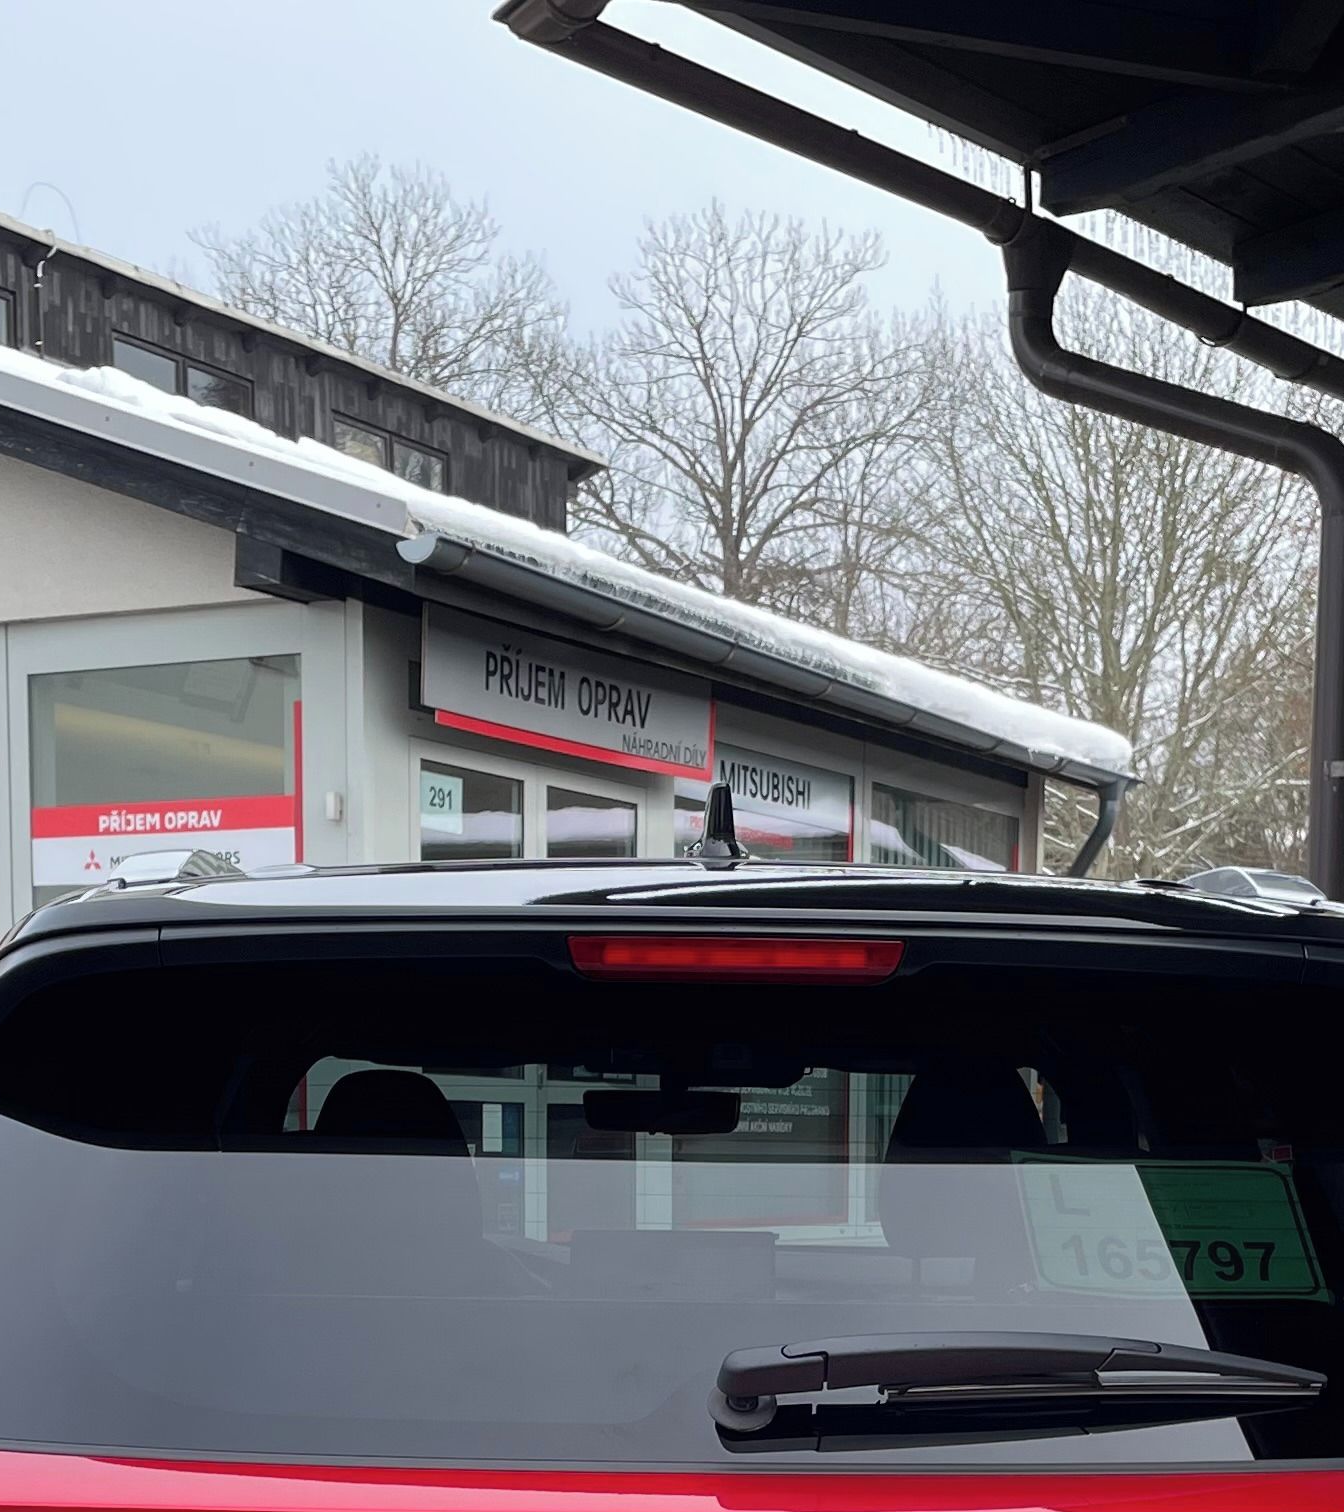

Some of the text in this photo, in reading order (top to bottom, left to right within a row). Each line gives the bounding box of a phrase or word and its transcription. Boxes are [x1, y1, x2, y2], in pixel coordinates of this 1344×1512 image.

[484, 643, 652, 729] PŘÍJEM OPRAV
[621, 731, 707, 769] NÁHRADNÍ DÍLY
[428, 785, 453, 811] 291
[720, 759, 811, 810] MITSUBISHI
[97, 809, 223, 833] PŘÍJEM OPRAV
[1049, 1173, 1091, 1217] L
[1060, 1234, 1277, 1283] 165797
